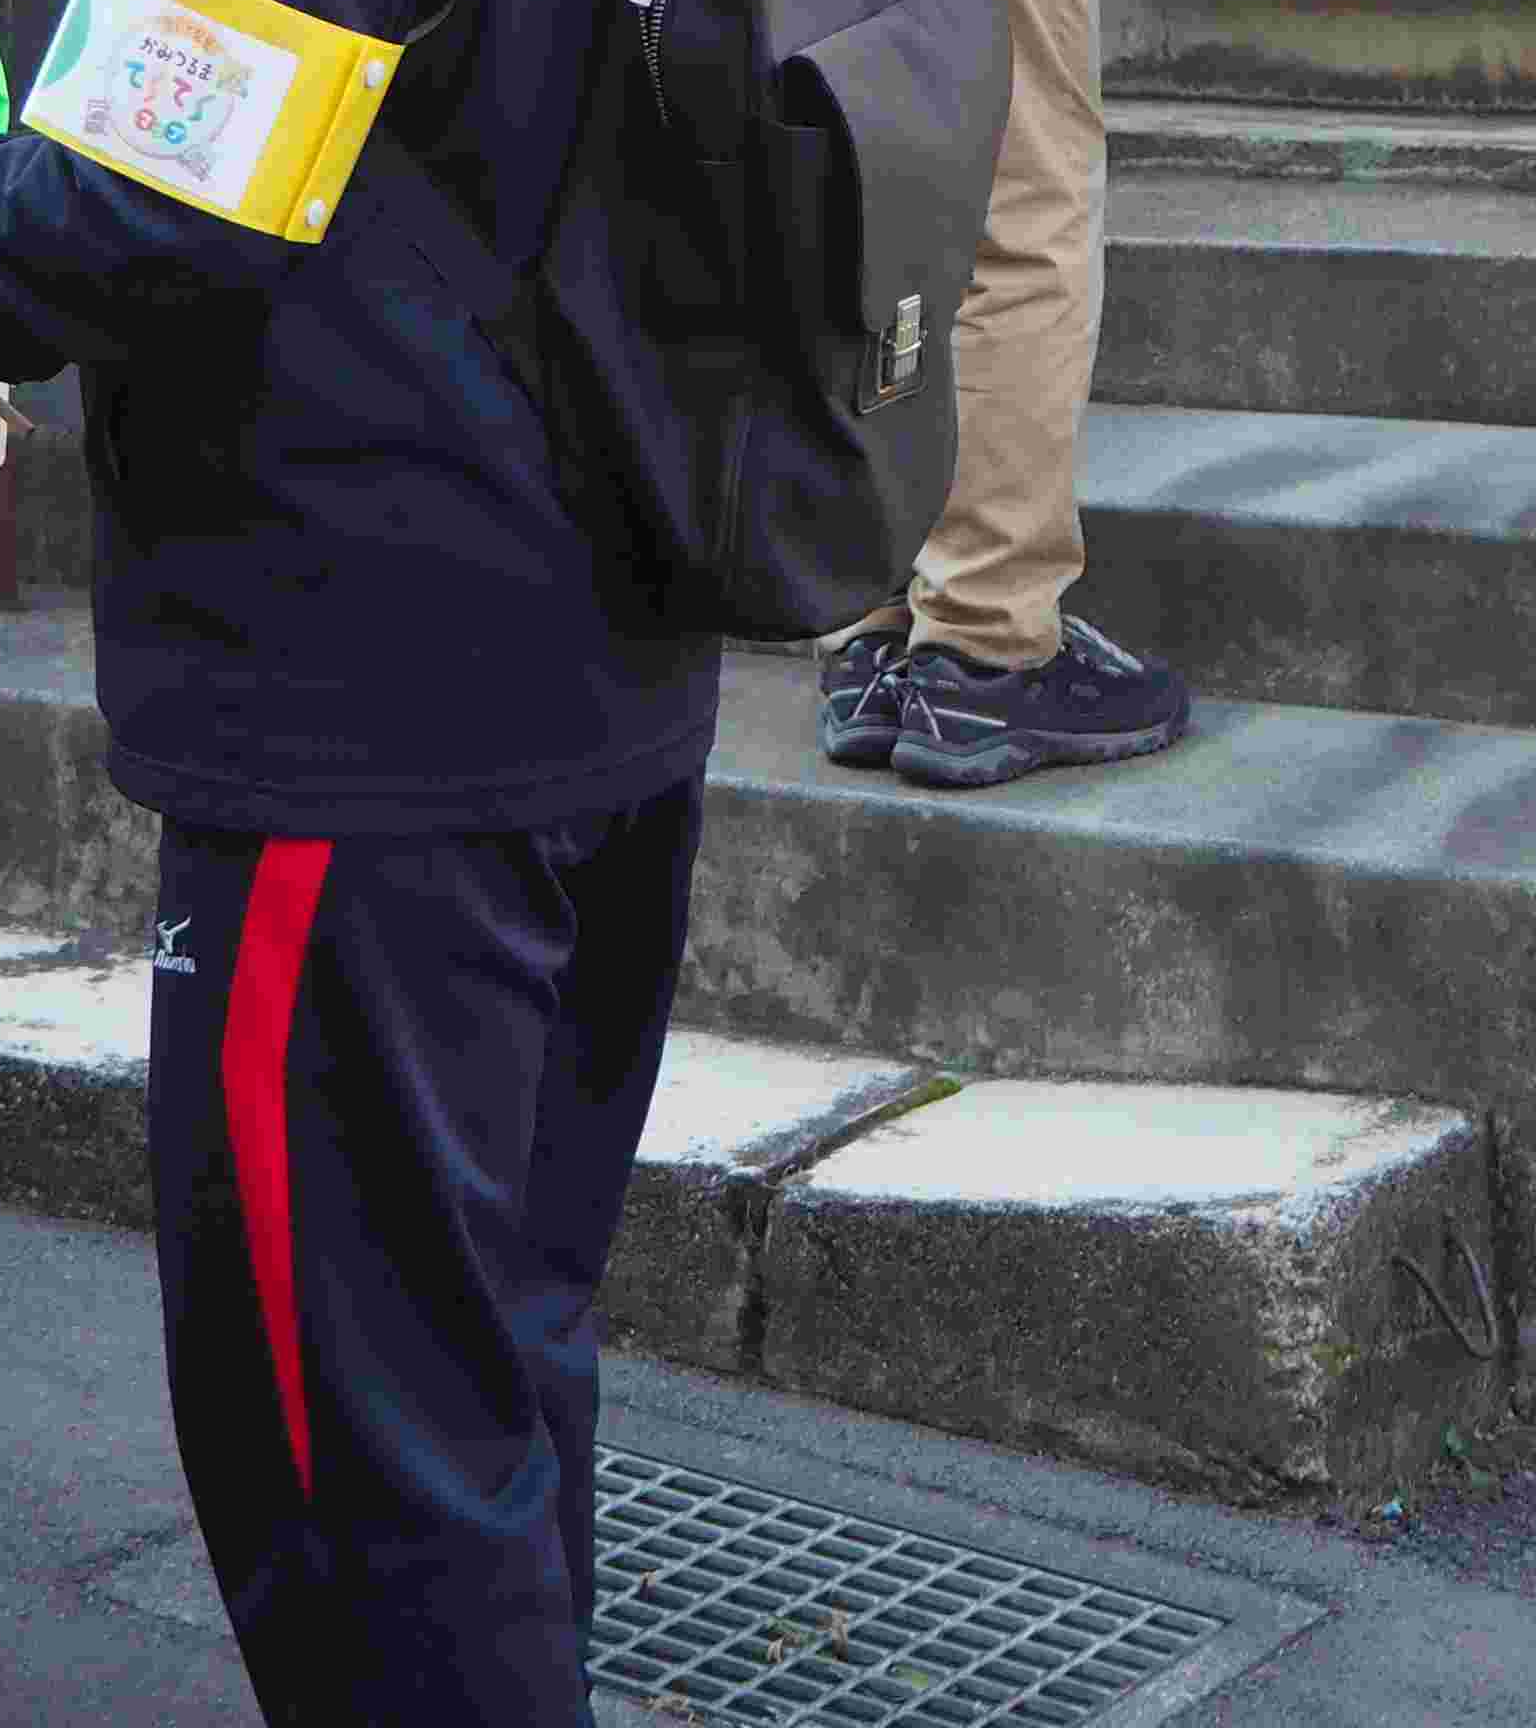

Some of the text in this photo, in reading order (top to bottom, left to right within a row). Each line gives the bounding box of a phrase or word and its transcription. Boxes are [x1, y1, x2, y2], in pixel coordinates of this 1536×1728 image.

[139, 36, 212, 81] かみつるま
